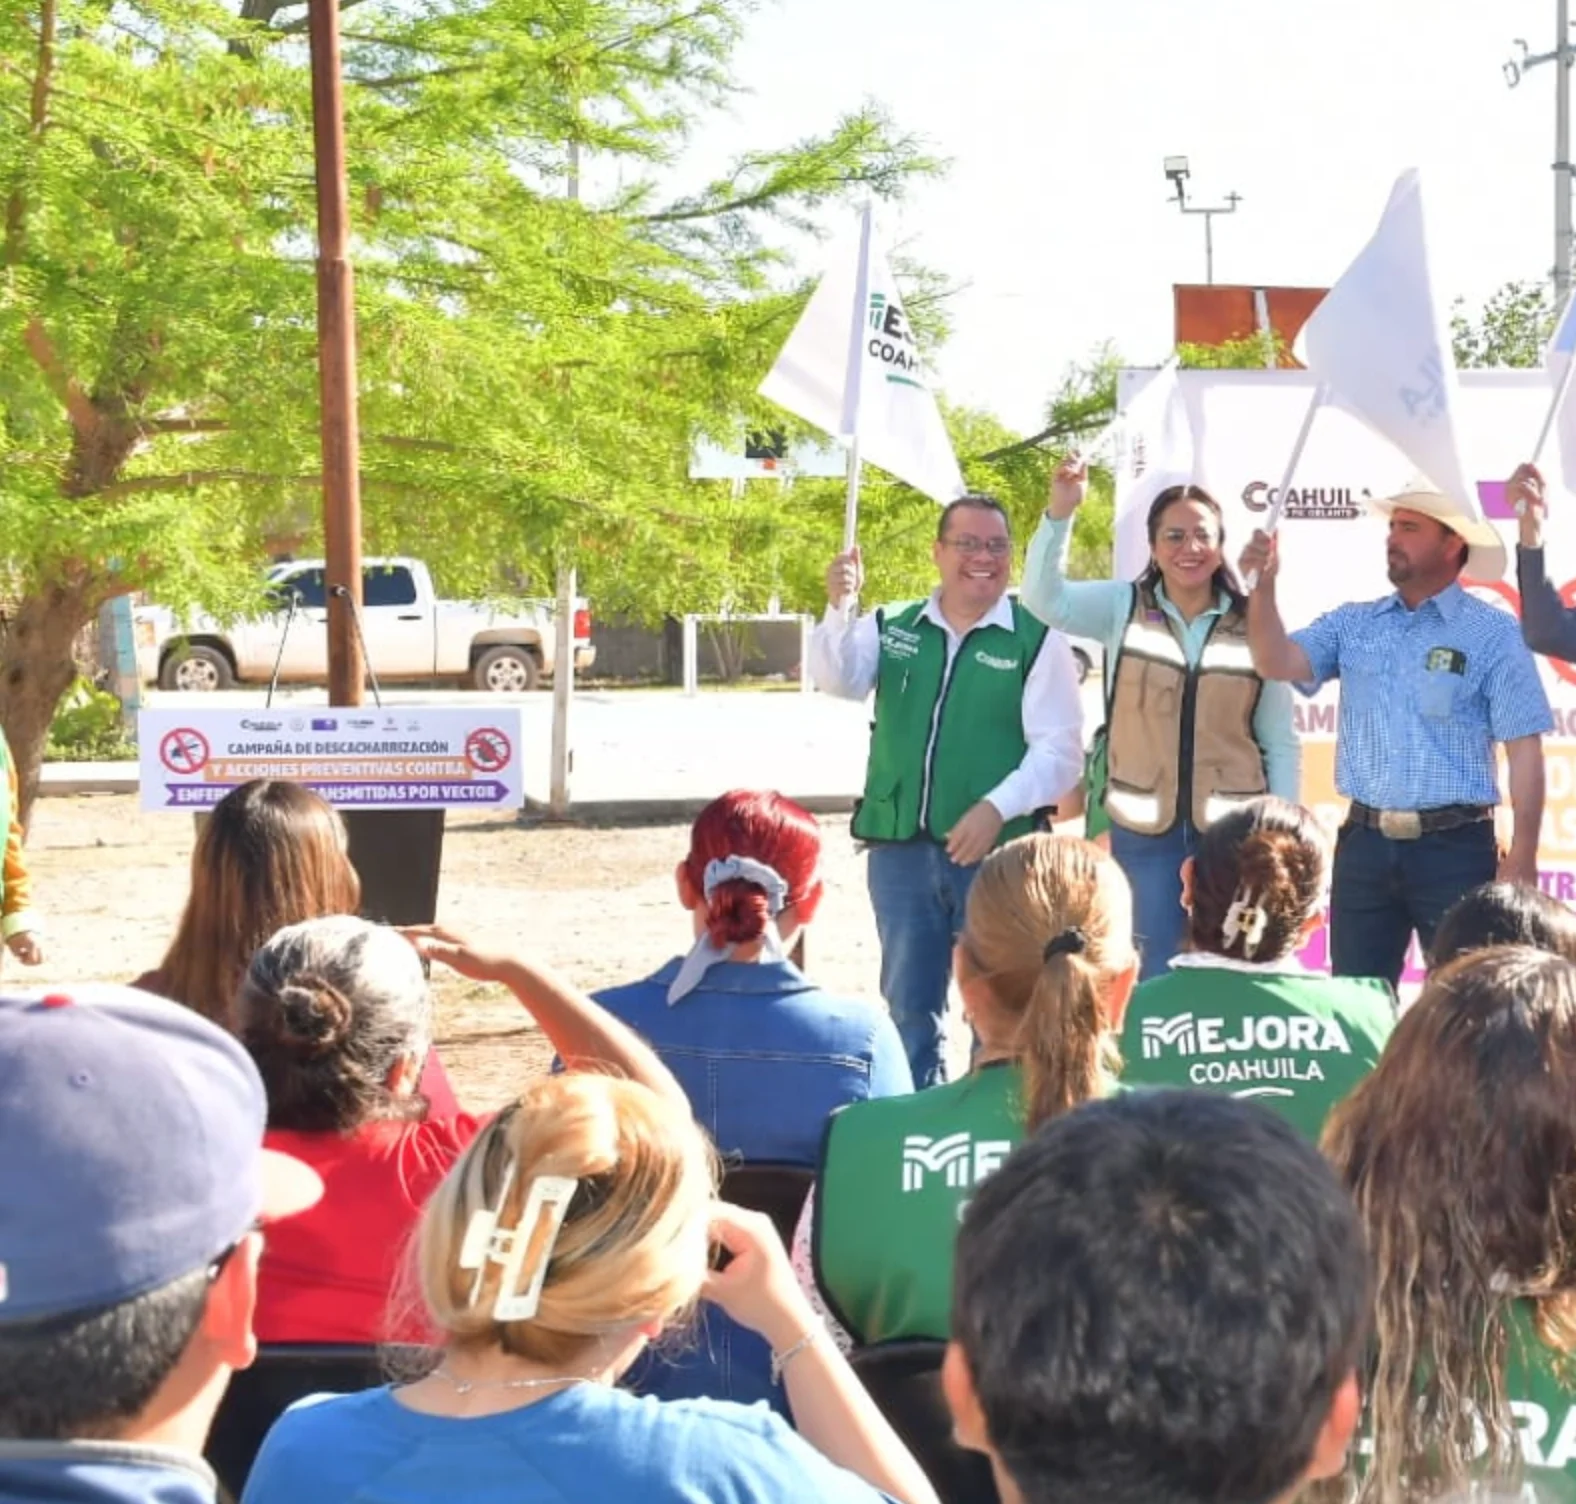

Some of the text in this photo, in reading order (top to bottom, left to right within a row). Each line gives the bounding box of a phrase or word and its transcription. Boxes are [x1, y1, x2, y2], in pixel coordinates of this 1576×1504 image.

[227, 740, 448, 755] CAMPAÑA DE DESCACHARRIZACIÓN
[211, 760, 467, 777] Y ACCIONES PREVENTIVAS CONTRA
[409, 785, 443, 799] POR
[444, 784, 496, 799] VECTOR
[1141, 1012, 1351, 1058] MEJORA
[1189, 1057, 1324, 1084] COAHUILA
